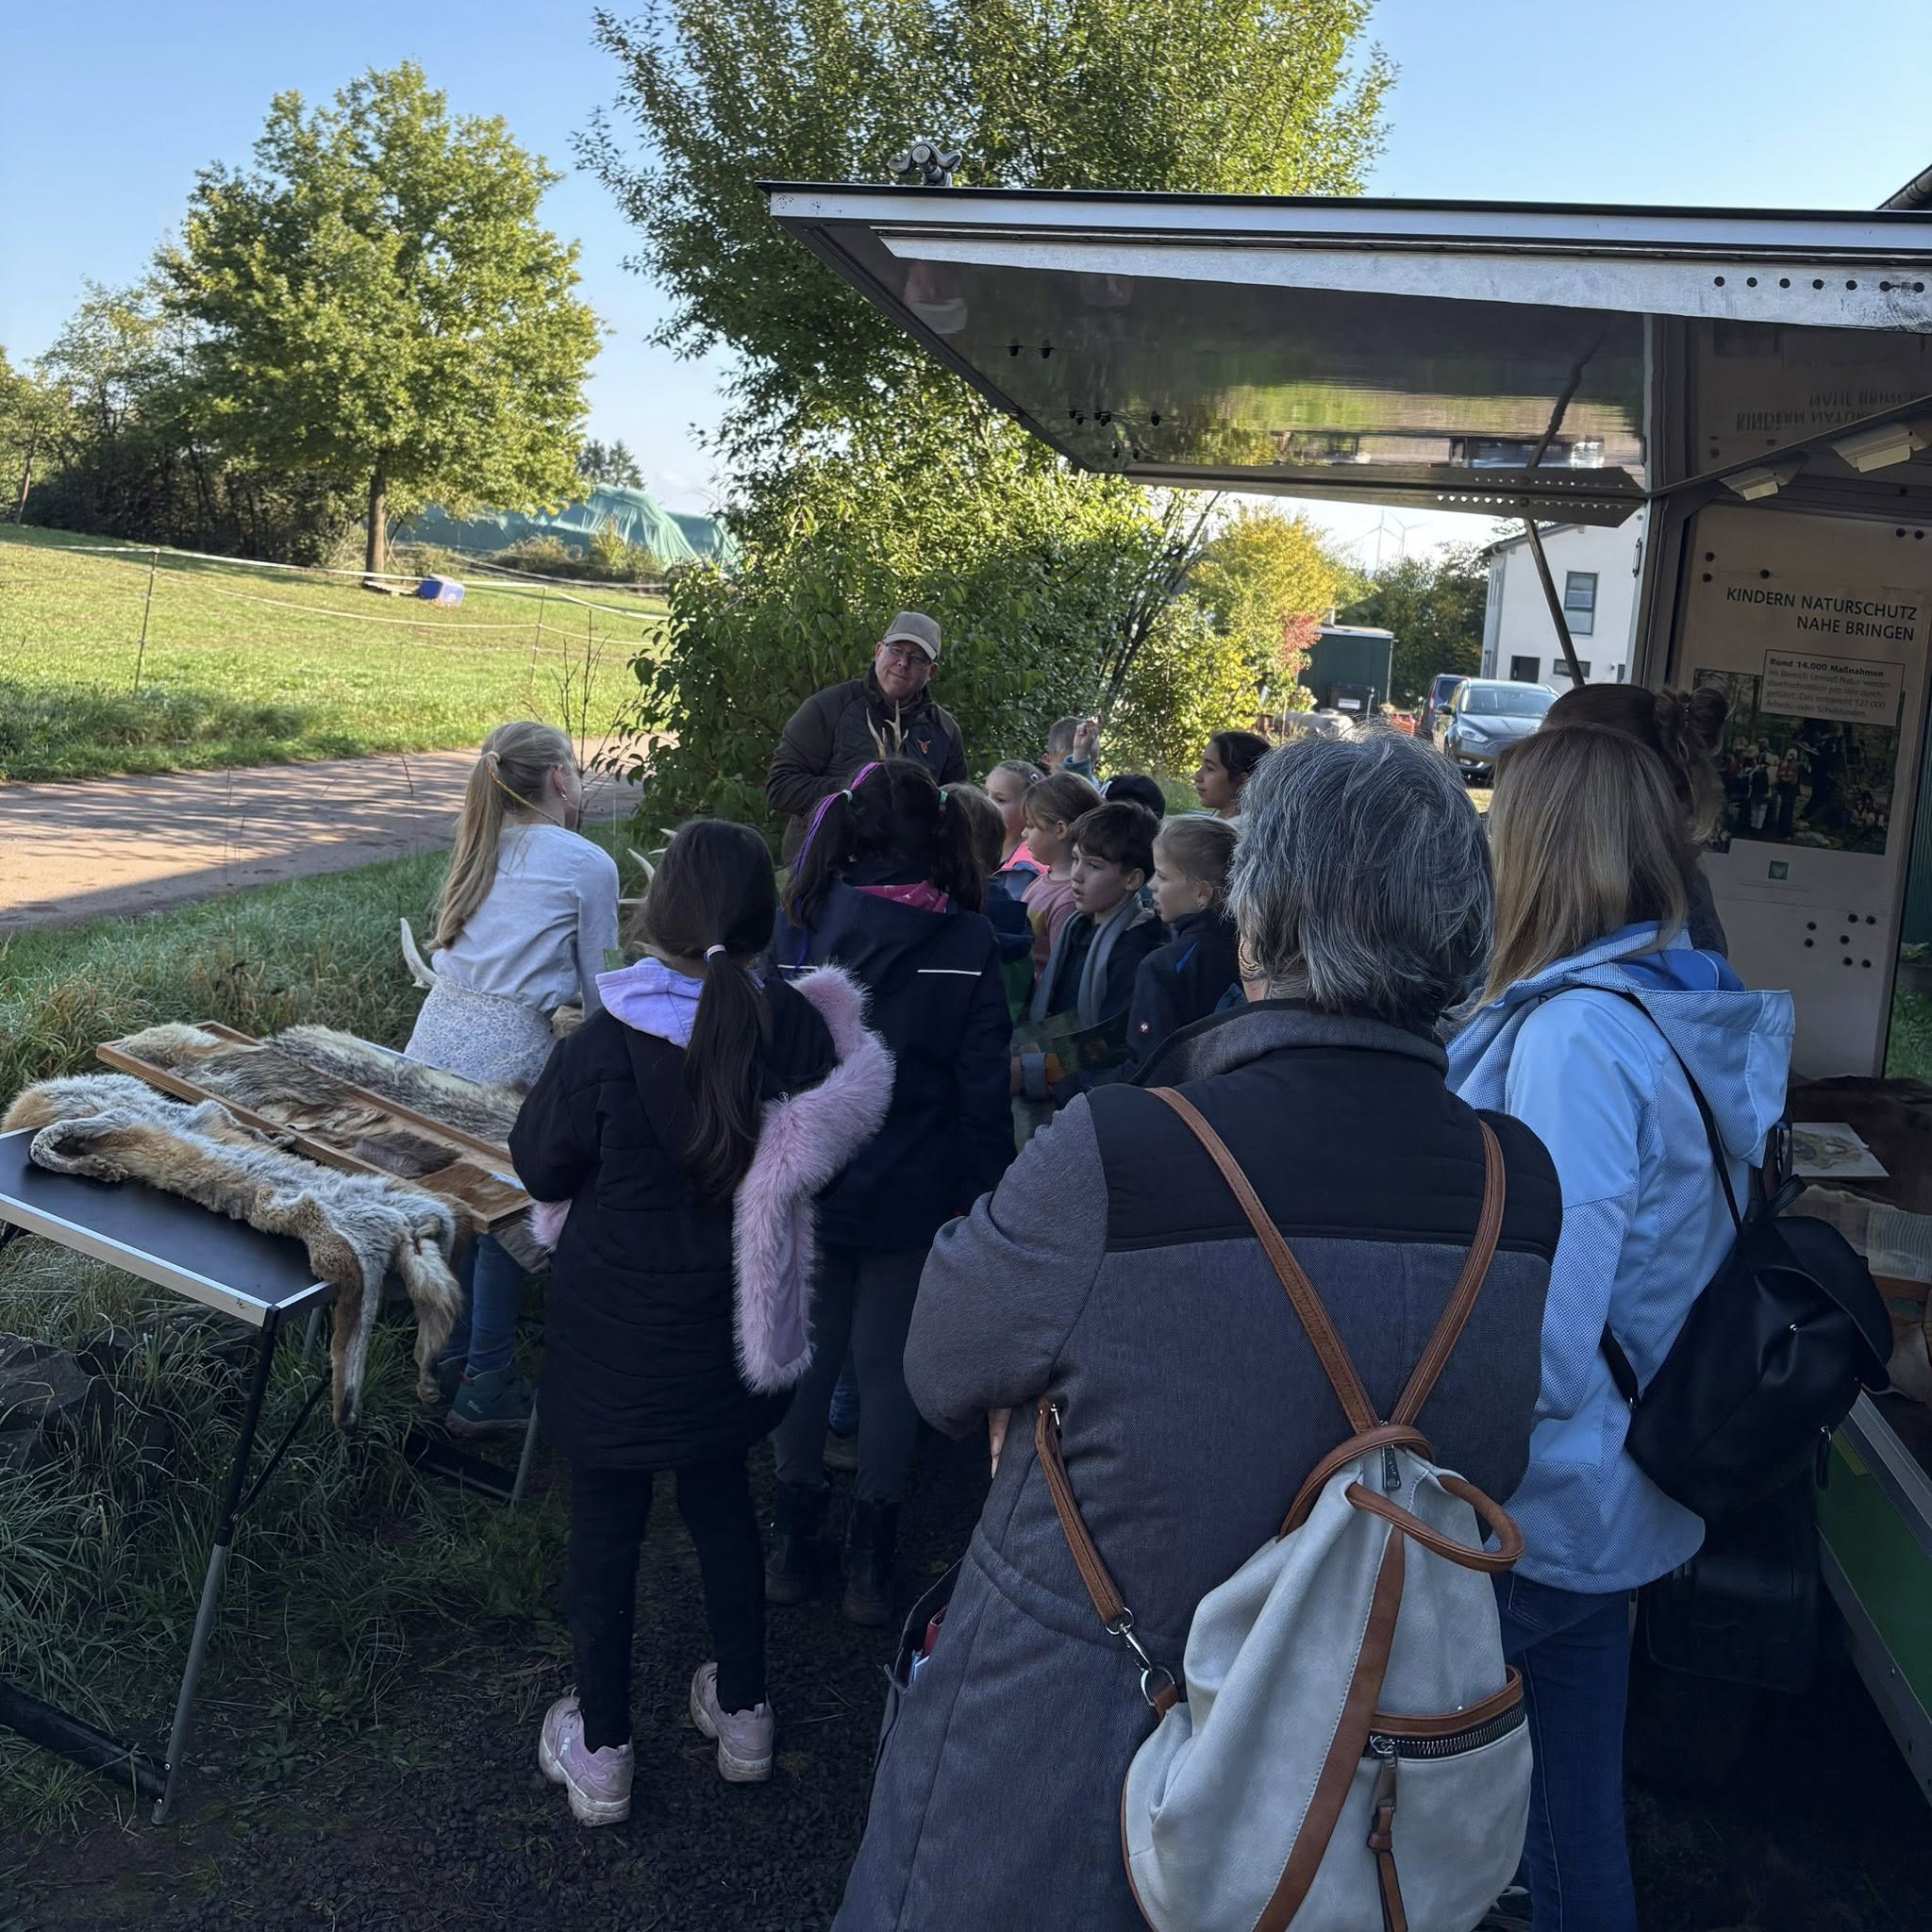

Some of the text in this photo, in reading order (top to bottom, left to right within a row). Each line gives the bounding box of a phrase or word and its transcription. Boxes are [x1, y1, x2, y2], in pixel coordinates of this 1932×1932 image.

[1726, 587, 1918, 621] KINDERN NATURSCHUTZ
[1797, 616, 1914, 641] NAHE BRINGEN
[1770, 658, 1884, 677] Rund 14.000 Maßnahmen
[1767, 678, 1827, 692] durchschnittlich
[1828, 687, 1841, 695] pro
[1840, 676, 1860, 686] Natur
[1863, 678, 1890, 688] werden
[1796, 703, 1814, 712] oder
[1855, 699, 1886, 709] 127.000
